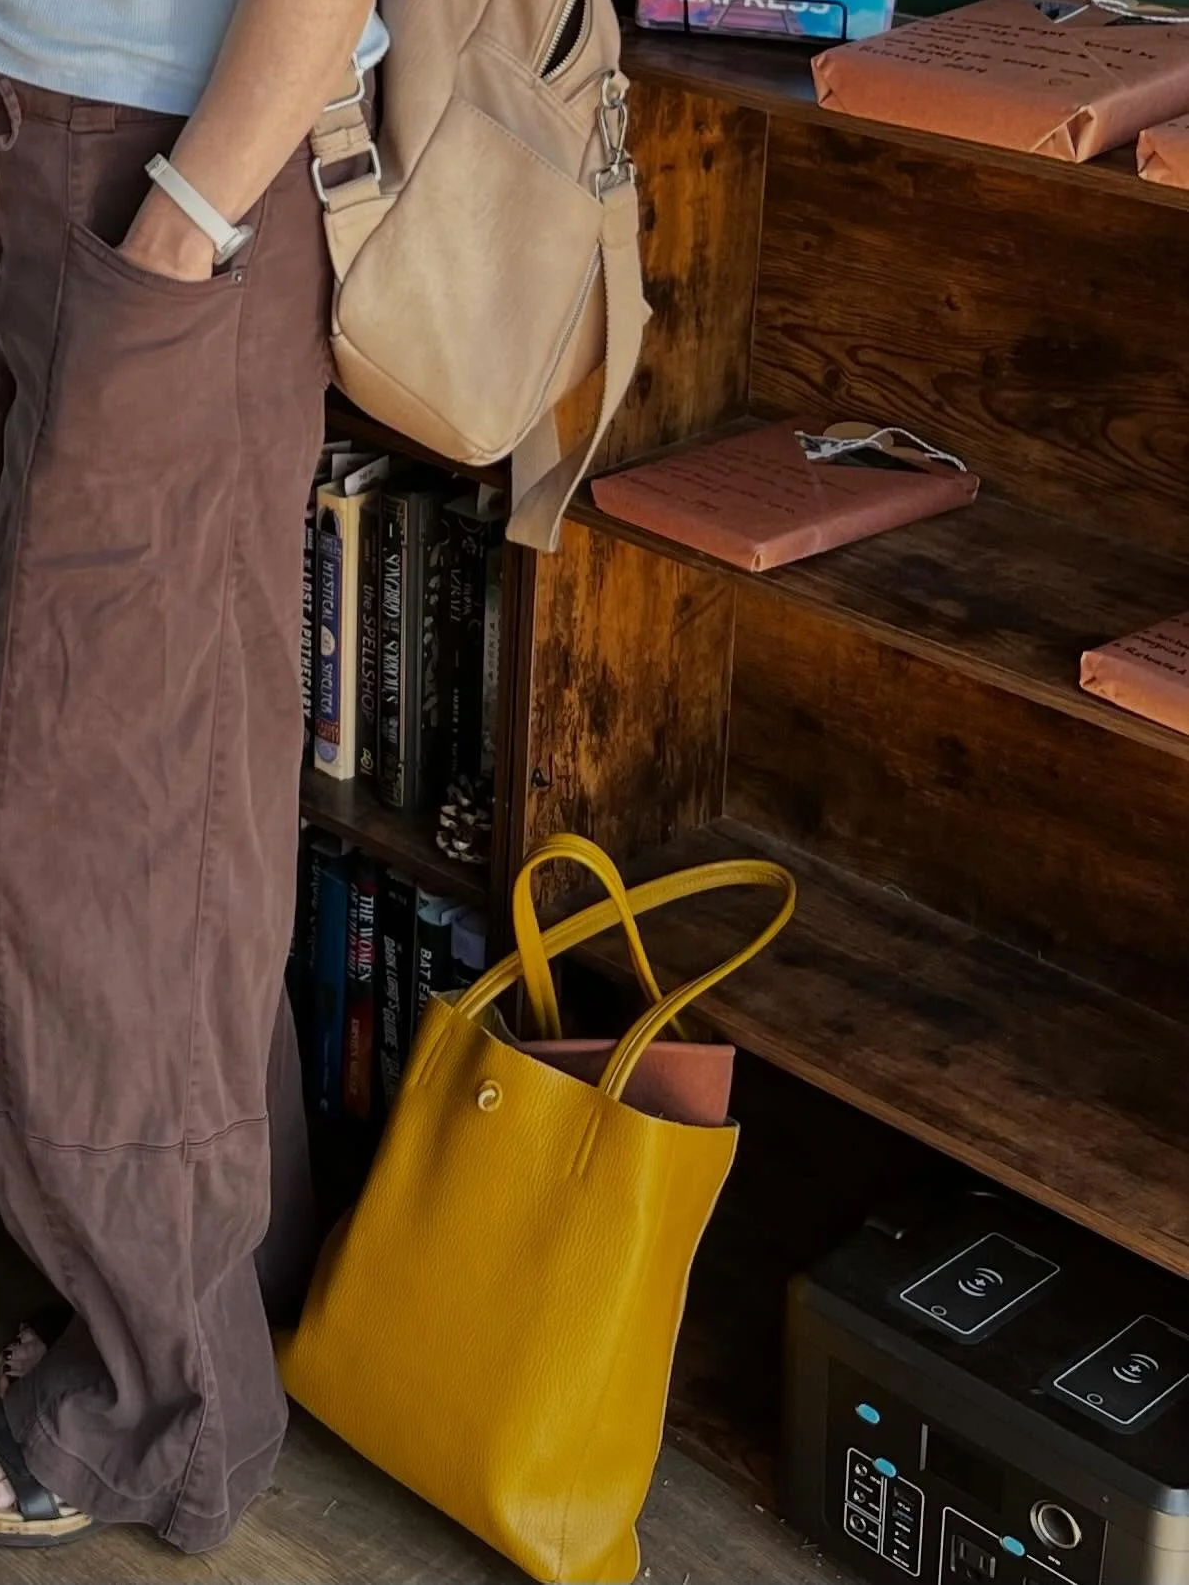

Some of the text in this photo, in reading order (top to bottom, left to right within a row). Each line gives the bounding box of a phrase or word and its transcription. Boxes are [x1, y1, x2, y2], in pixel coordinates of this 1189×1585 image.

[362, 583, 377, 611] the
[361, 612, 377, 726] SPELLSHOP
[357, 894, 376, 984] THE WOMEN
[418, 947, 433, 981] BAT
